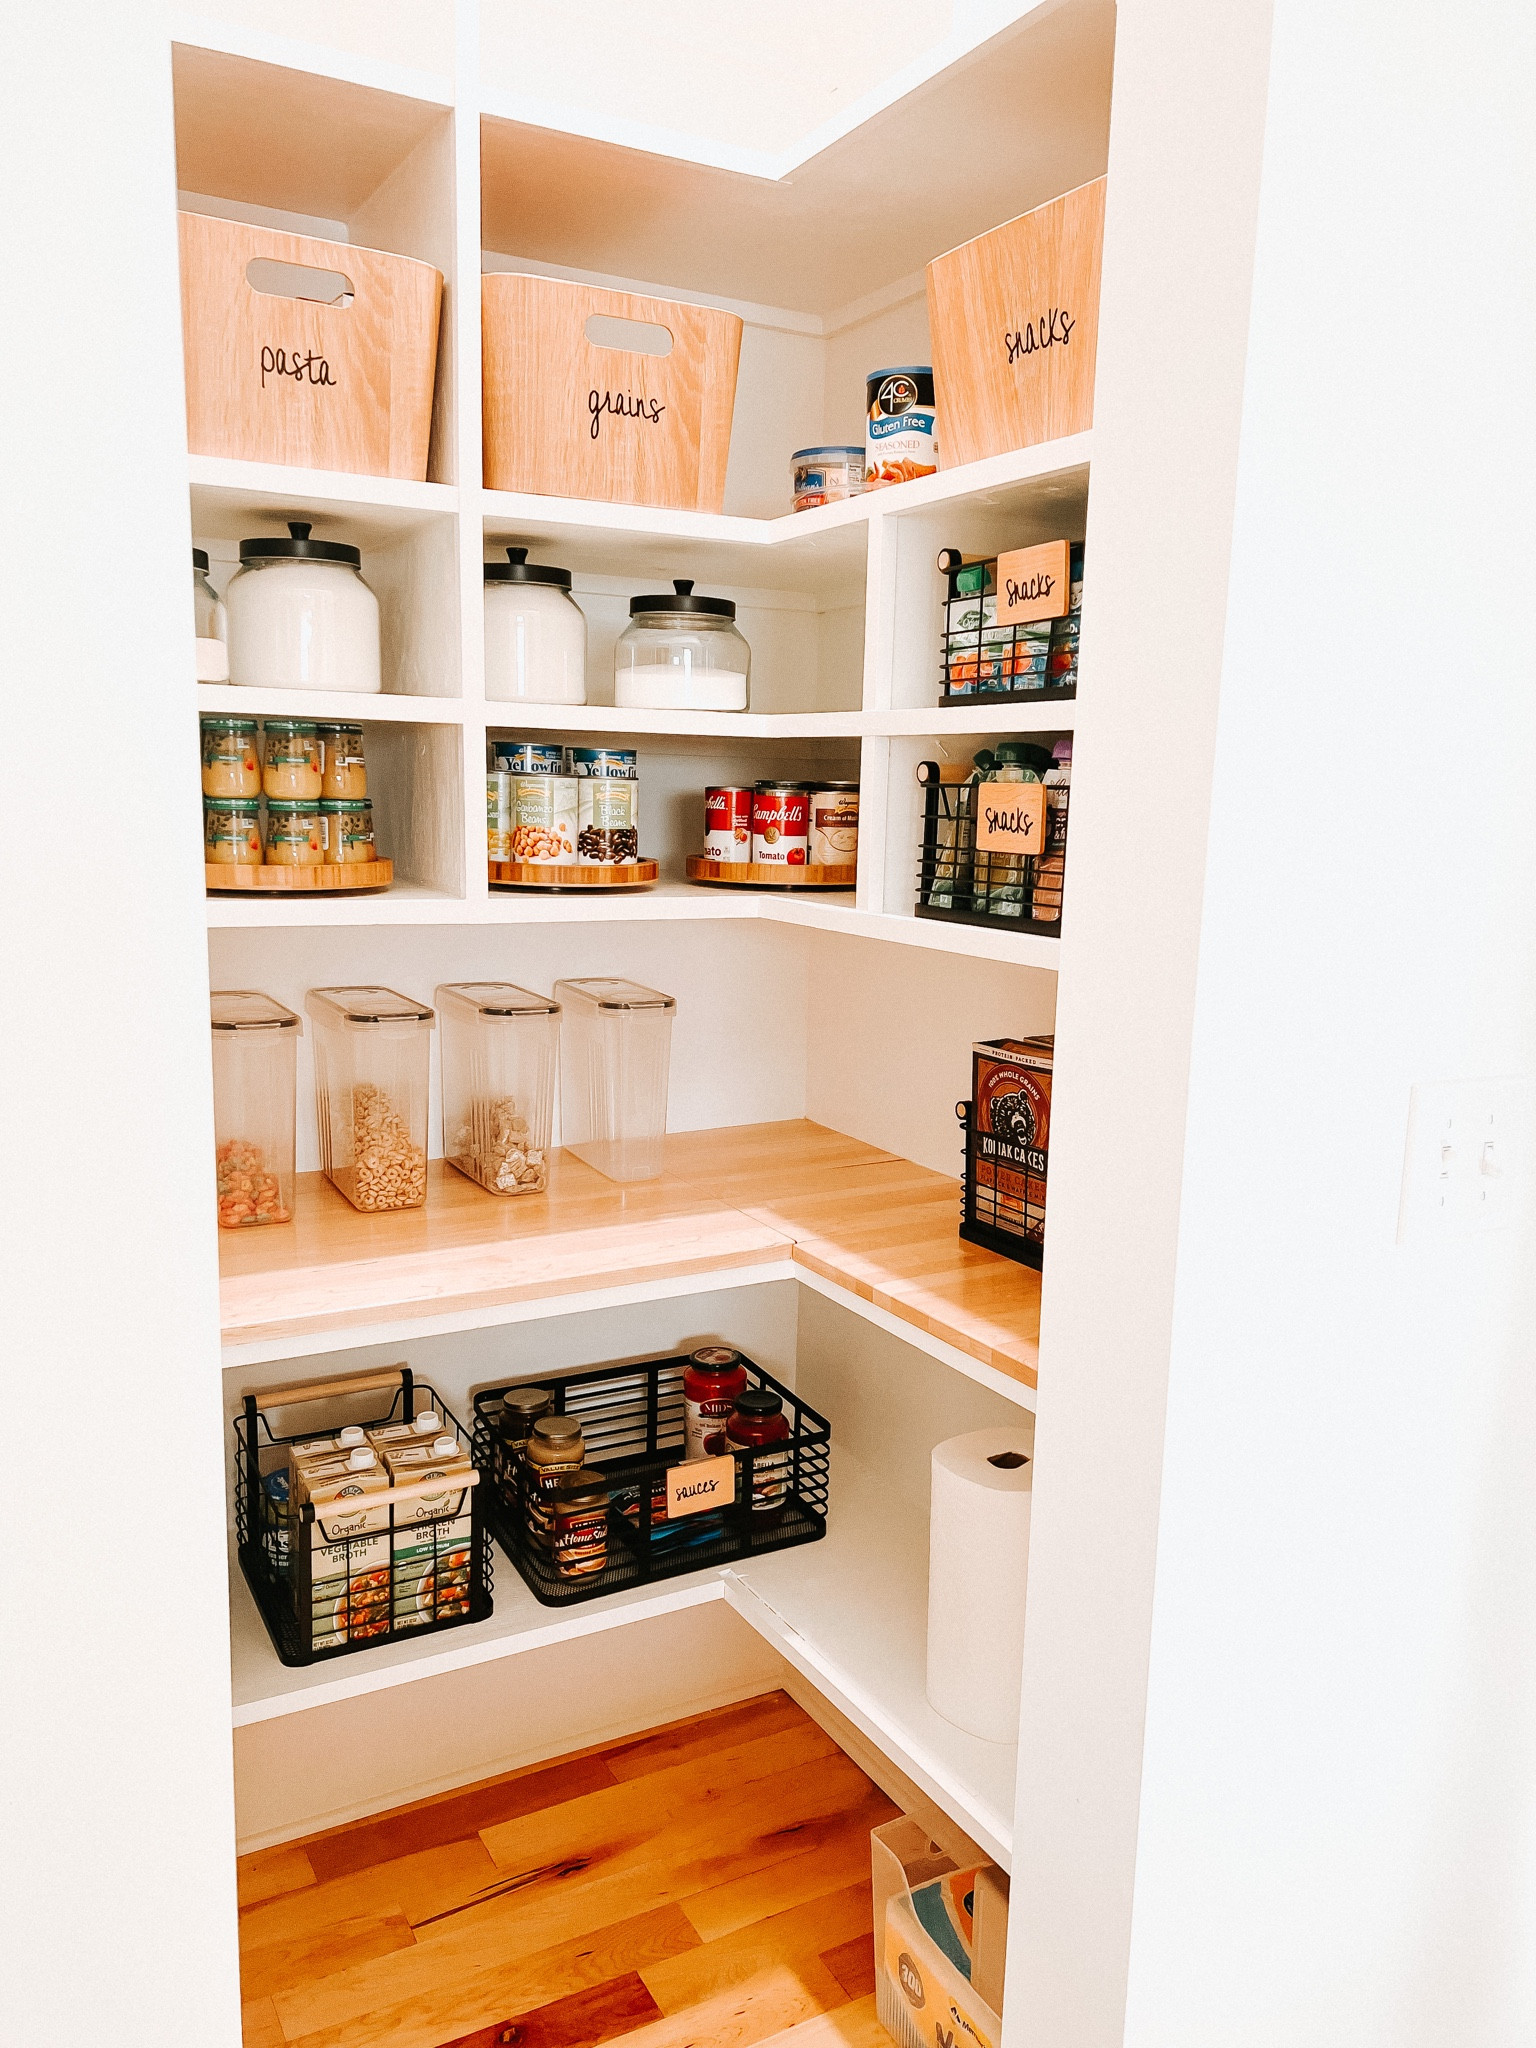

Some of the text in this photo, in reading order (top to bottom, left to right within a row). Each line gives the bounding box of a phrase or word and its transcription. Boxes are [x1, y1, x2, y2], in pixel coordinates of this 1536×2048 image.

[1004, 308, 1076, 364] snacks
[261, 346, 337, 389] pasta
[588, 389, 666, 439] grains
[872, 416, 926, 436] Gluten Free
[1005, 573, 1056, 607] snacks
[753, 803, 802, 824] Campbell's
[985, 808, 1033, 836] snacks
[758, 850, 785, 860] Tomato
[1015, 1056, 1037, 1065] PACKED
[998, 1070, 1020, 1081] WHOLE
[1019, 1076, 1041, 1101] GRAINS
[981, 1164, 1011, 1180] POER
[541, 1465, 564, 1473] VALUE
[676, 1480, 720, 1501] sauces
[416, 1505, 449, 1519] Organic
[331, 1522, 366, 1536] Organic
[416, 1527, 450, 1540] BROTH
[332, 1548, 367, 1563] BROTH
